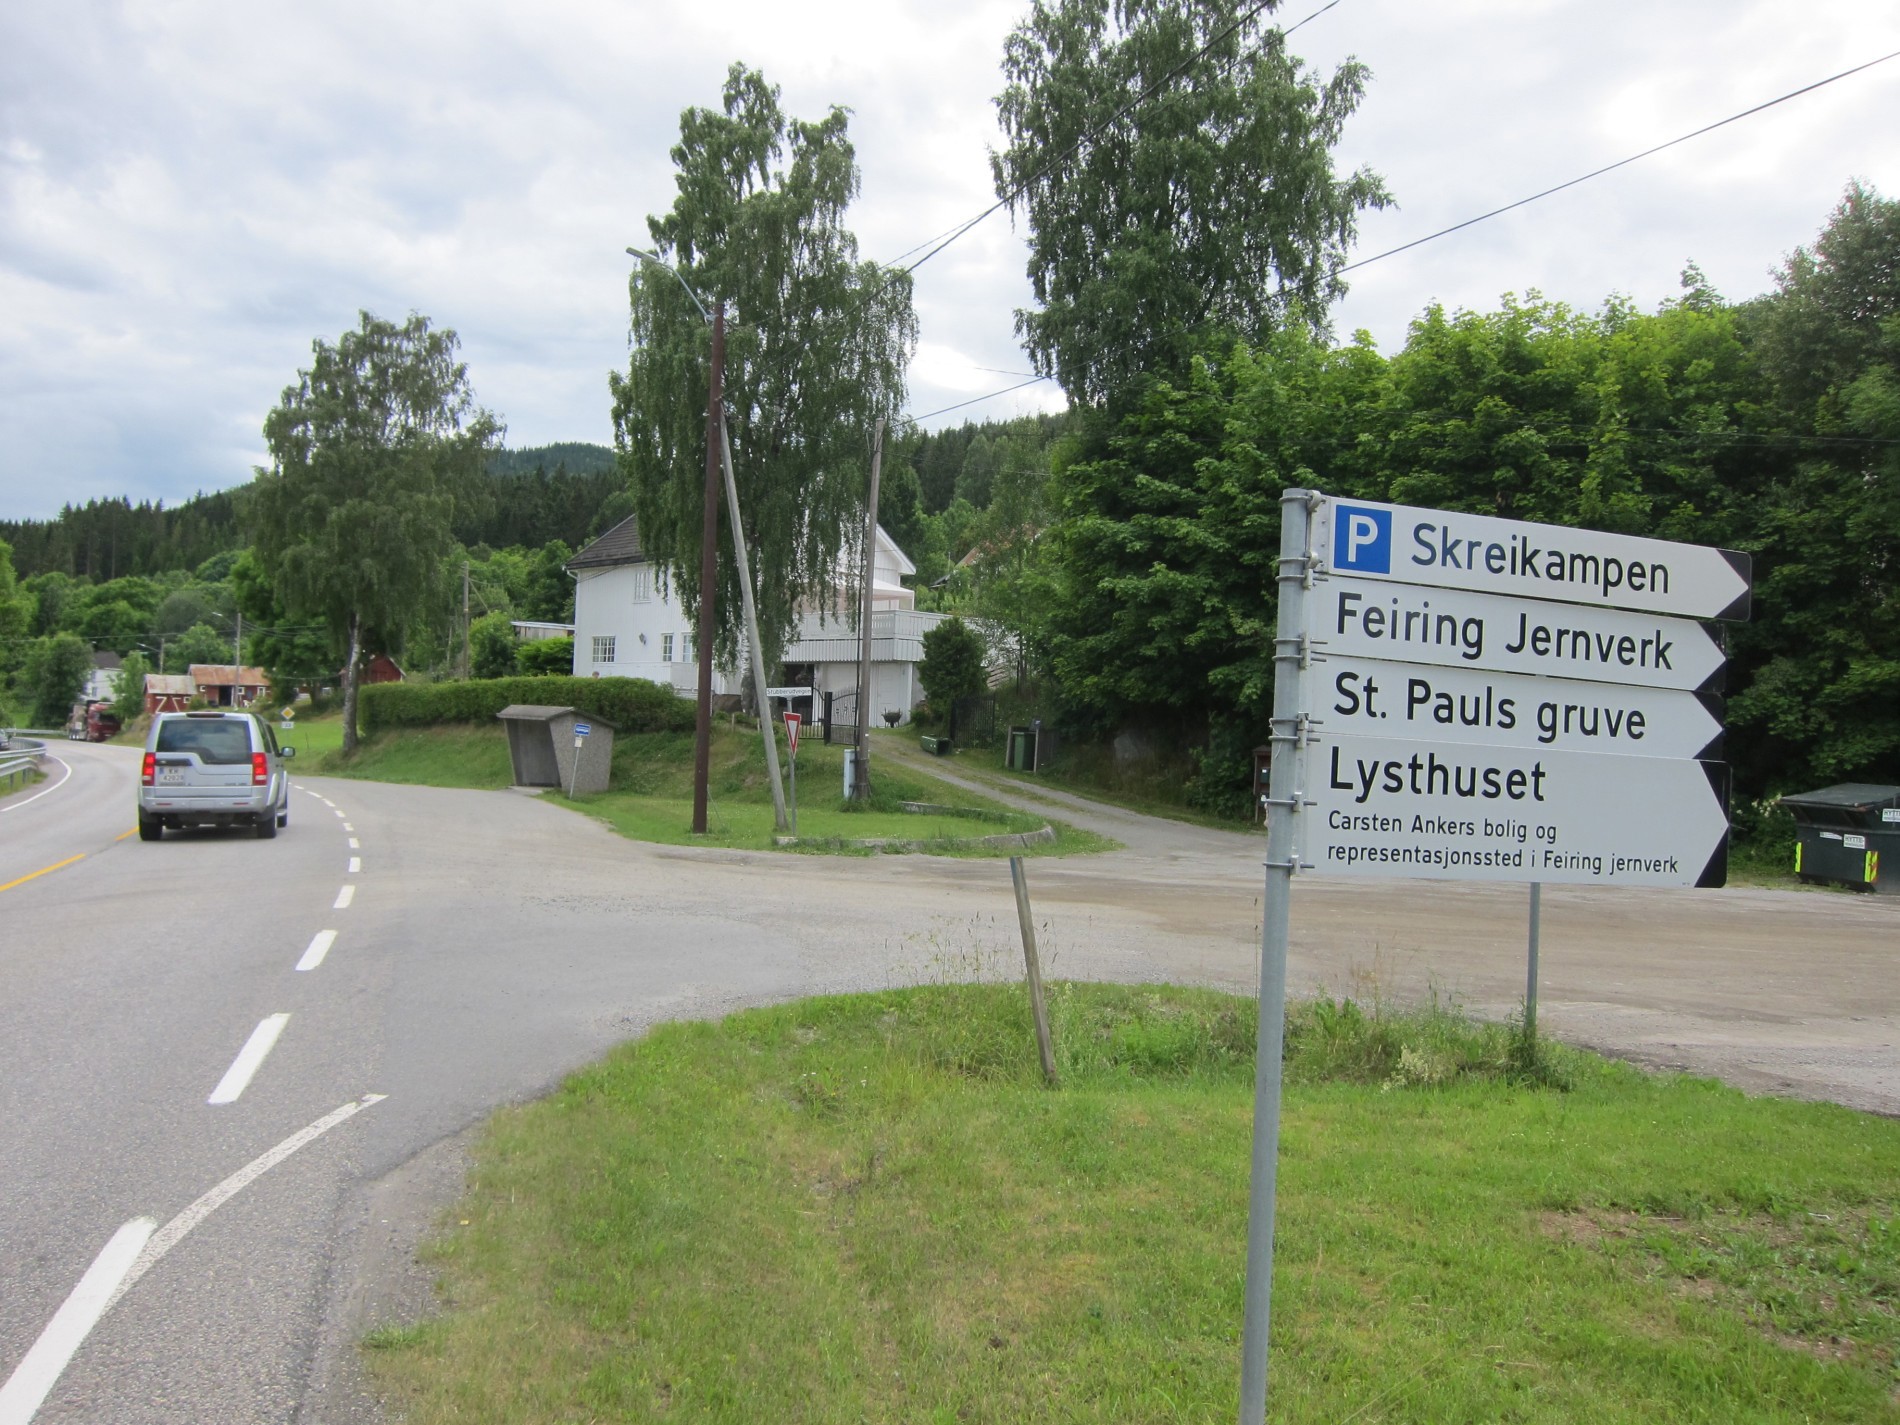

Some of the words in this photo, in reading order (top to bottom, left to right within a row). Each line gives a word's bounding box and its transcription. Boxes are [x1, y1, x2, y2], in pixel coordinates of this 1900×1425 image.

[1348, 514, 1379, 562] P
[1411, 522, 1669, 597] Skreikampen
[1337, 591, 1484, 660] Feiring
[1505, 612, 1673, 670] Jernverk
[1334, 671, 1387, 719] St.
[1406, 677, 1517, 730] Pauls
[1536, 701, 1646, 744] gruve
[1330, 746, 1546, 803] Lysthuset
[1328, 810, 1402, 833] Carsten
[1411, 814, 1475, 836] Ankers
[1484, 817, 1527, 843] bolig
[1535, 825, 1557, 845] og
[1328, 844, 1522, 870] representasjonssted
[1530, 851, 1537, 867] i
[1543, 850, 1602, 875] Feiring
[1609, 852, 1679, 876] jernverk
